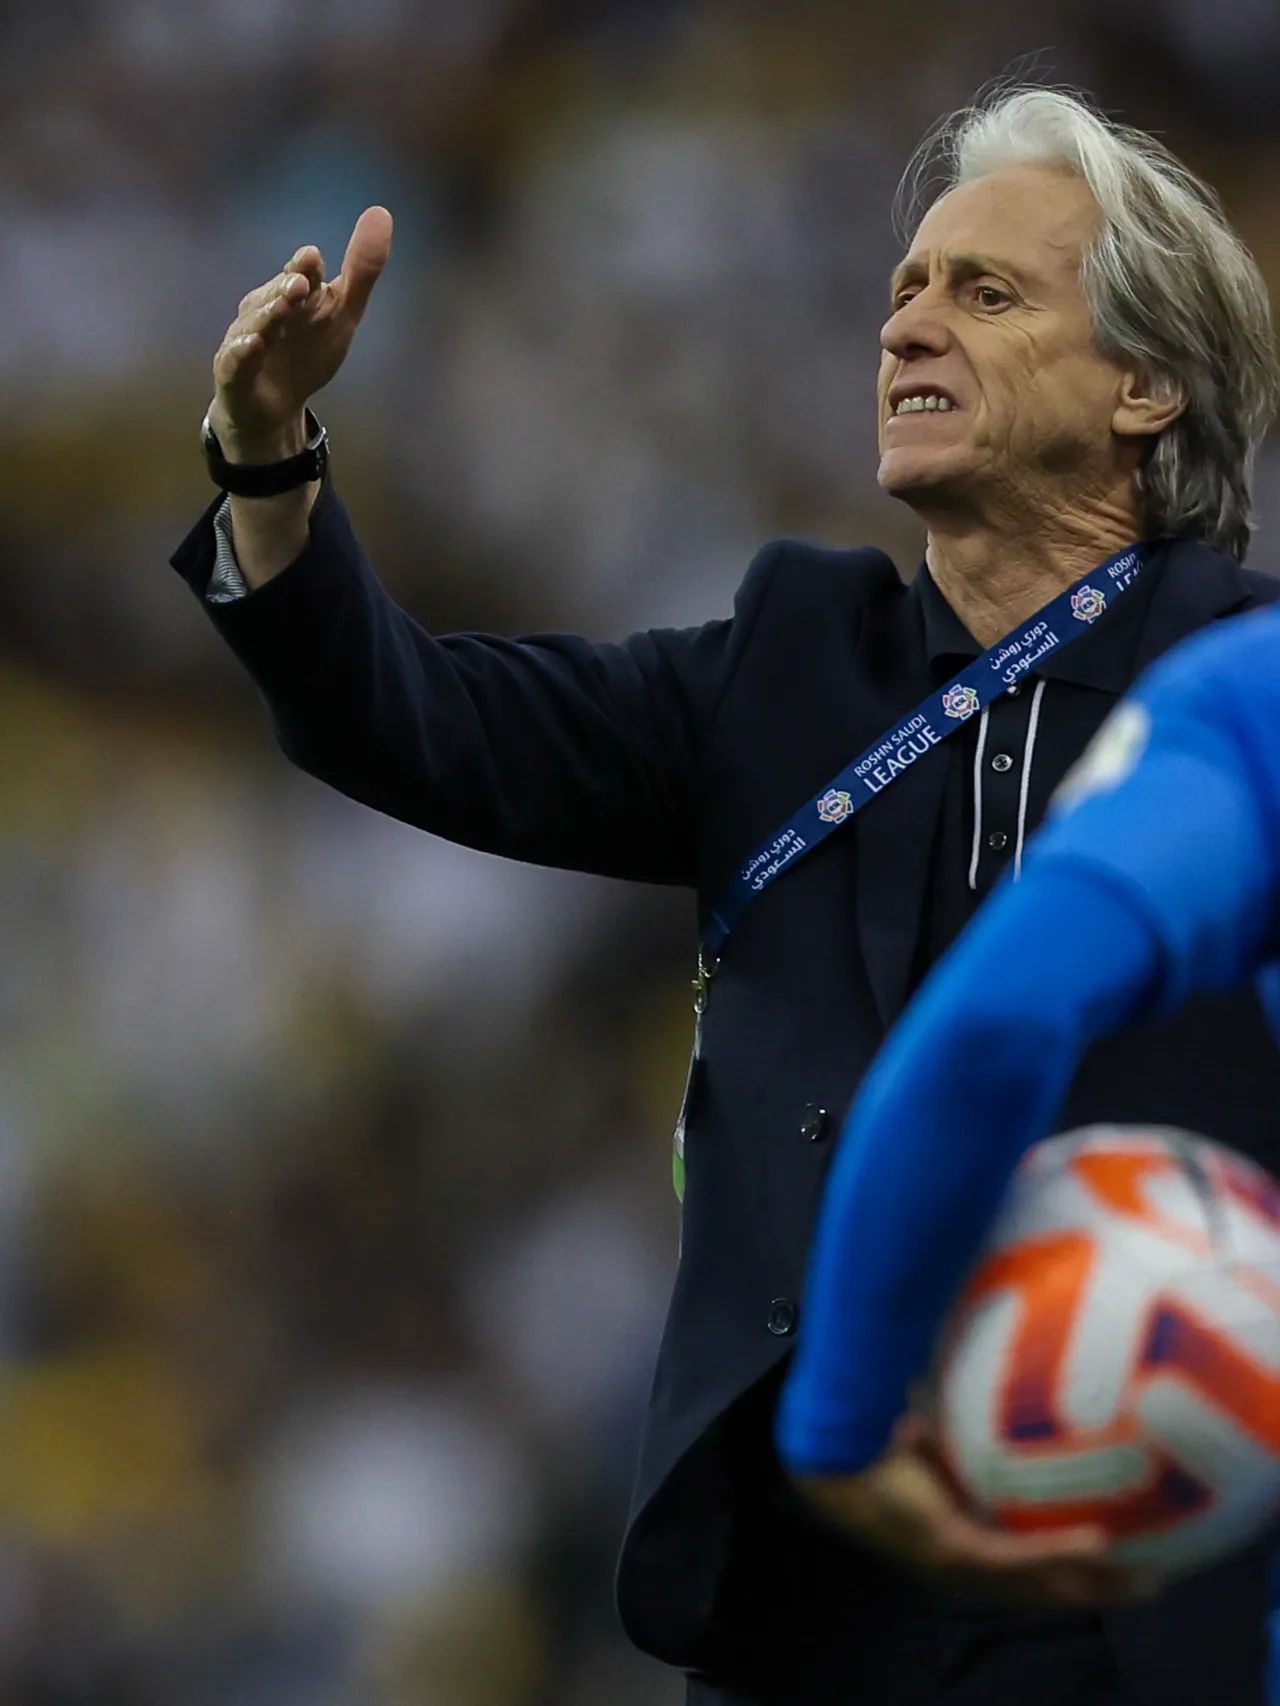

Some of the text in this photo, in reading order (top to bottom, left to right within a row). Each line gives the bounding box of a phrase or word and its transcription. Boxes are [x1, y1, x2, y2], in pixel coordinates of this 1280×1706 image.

[990, 621, 1048, 670] دوري روشن
[1002, 631, 1060, 685] السعودي
[854, 714, 927, 777] ROSHN SAUDI
[863, 724, 942, 793] LEAGUE
[751, 836, 807, 890] السعودي
[770, 829, 796, 855] دوري
